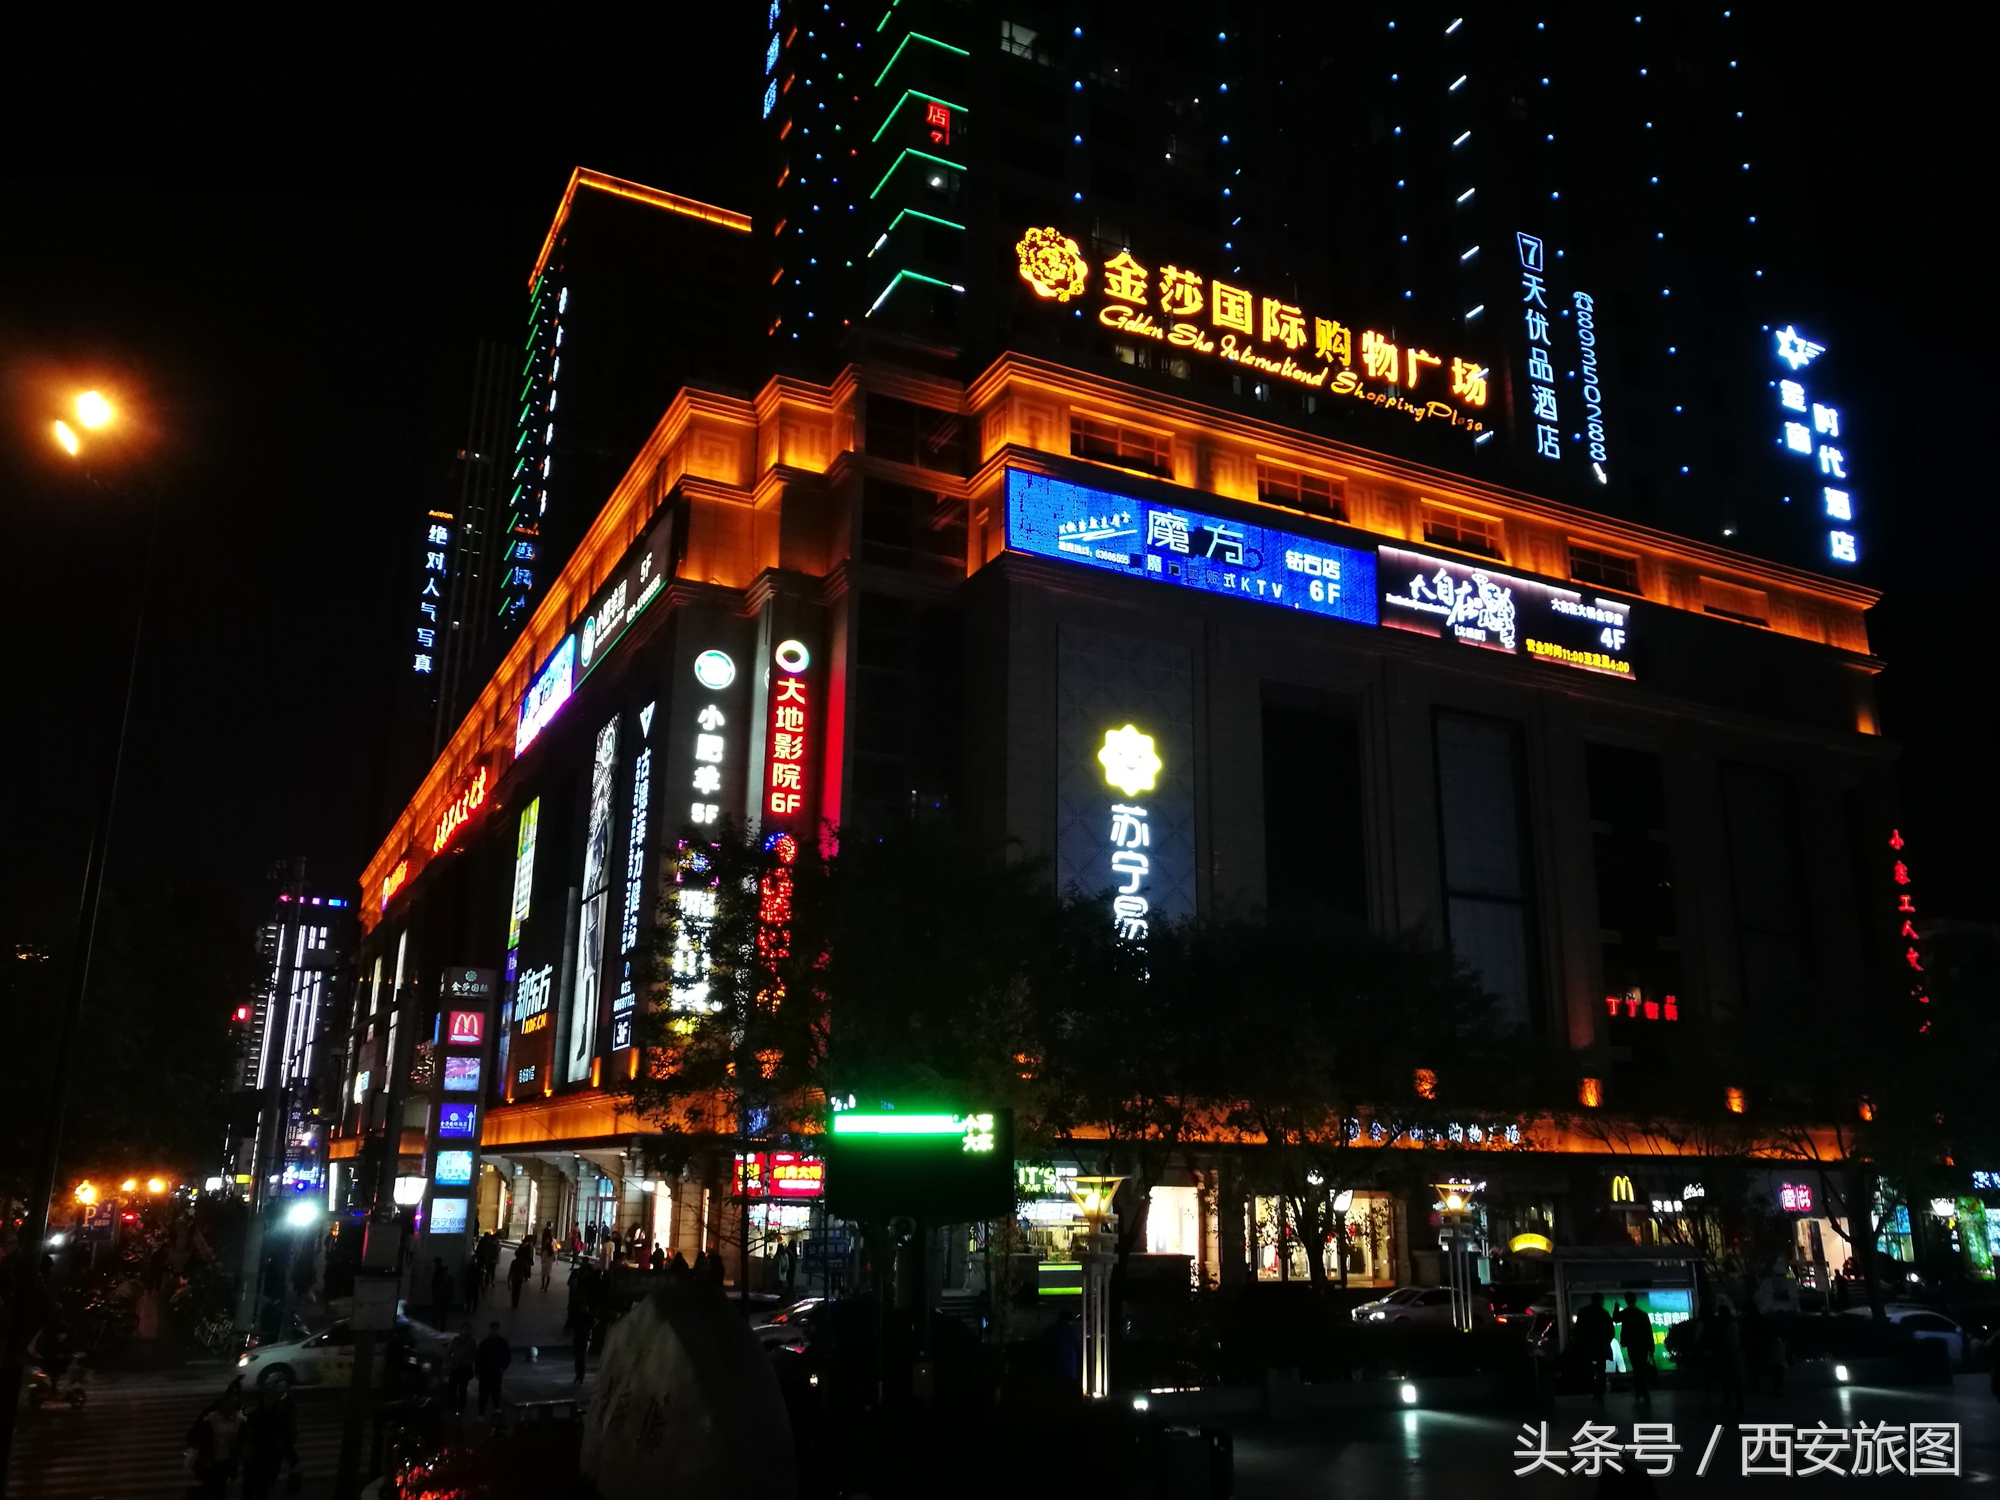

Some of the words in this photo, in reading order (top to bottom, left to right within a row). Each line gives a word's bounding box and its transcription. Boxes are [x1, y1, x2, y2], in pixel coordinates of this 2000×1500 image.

[1102, 251, 1489, 405] 金莎国际购物广场
[1517, 232, 1561, 460] 7天优品酒店
[1101, 305, 1163, 341] Golden
[1168, 323, 1216, 355] Sha
[1219, 334, 1325, 388] International
[1330, 370, 1425, 422] Shopping
[1427, 401, 1485, 432] Plaza
[1577, 312, 1607, 462] 89350288
[1147, 510, 1244, 565] 魔方
[1286, 549, 1341, 580] 钻石店
[413, 525, 448, 674] 绝对人气写真
[1309, 580, 1341, 604] 6F
[1600, 627, 1626, 650] 4F
[695, 704, 726, 794] 小肥羊
[773, 677, 806, 791] 大地影院
[691, 803, 719, 824] 5F
[771, 791, 801, 814] 6F
[515, 963, 553, 1034] 新东方
[616, 1021, 630, 1044] 3F
